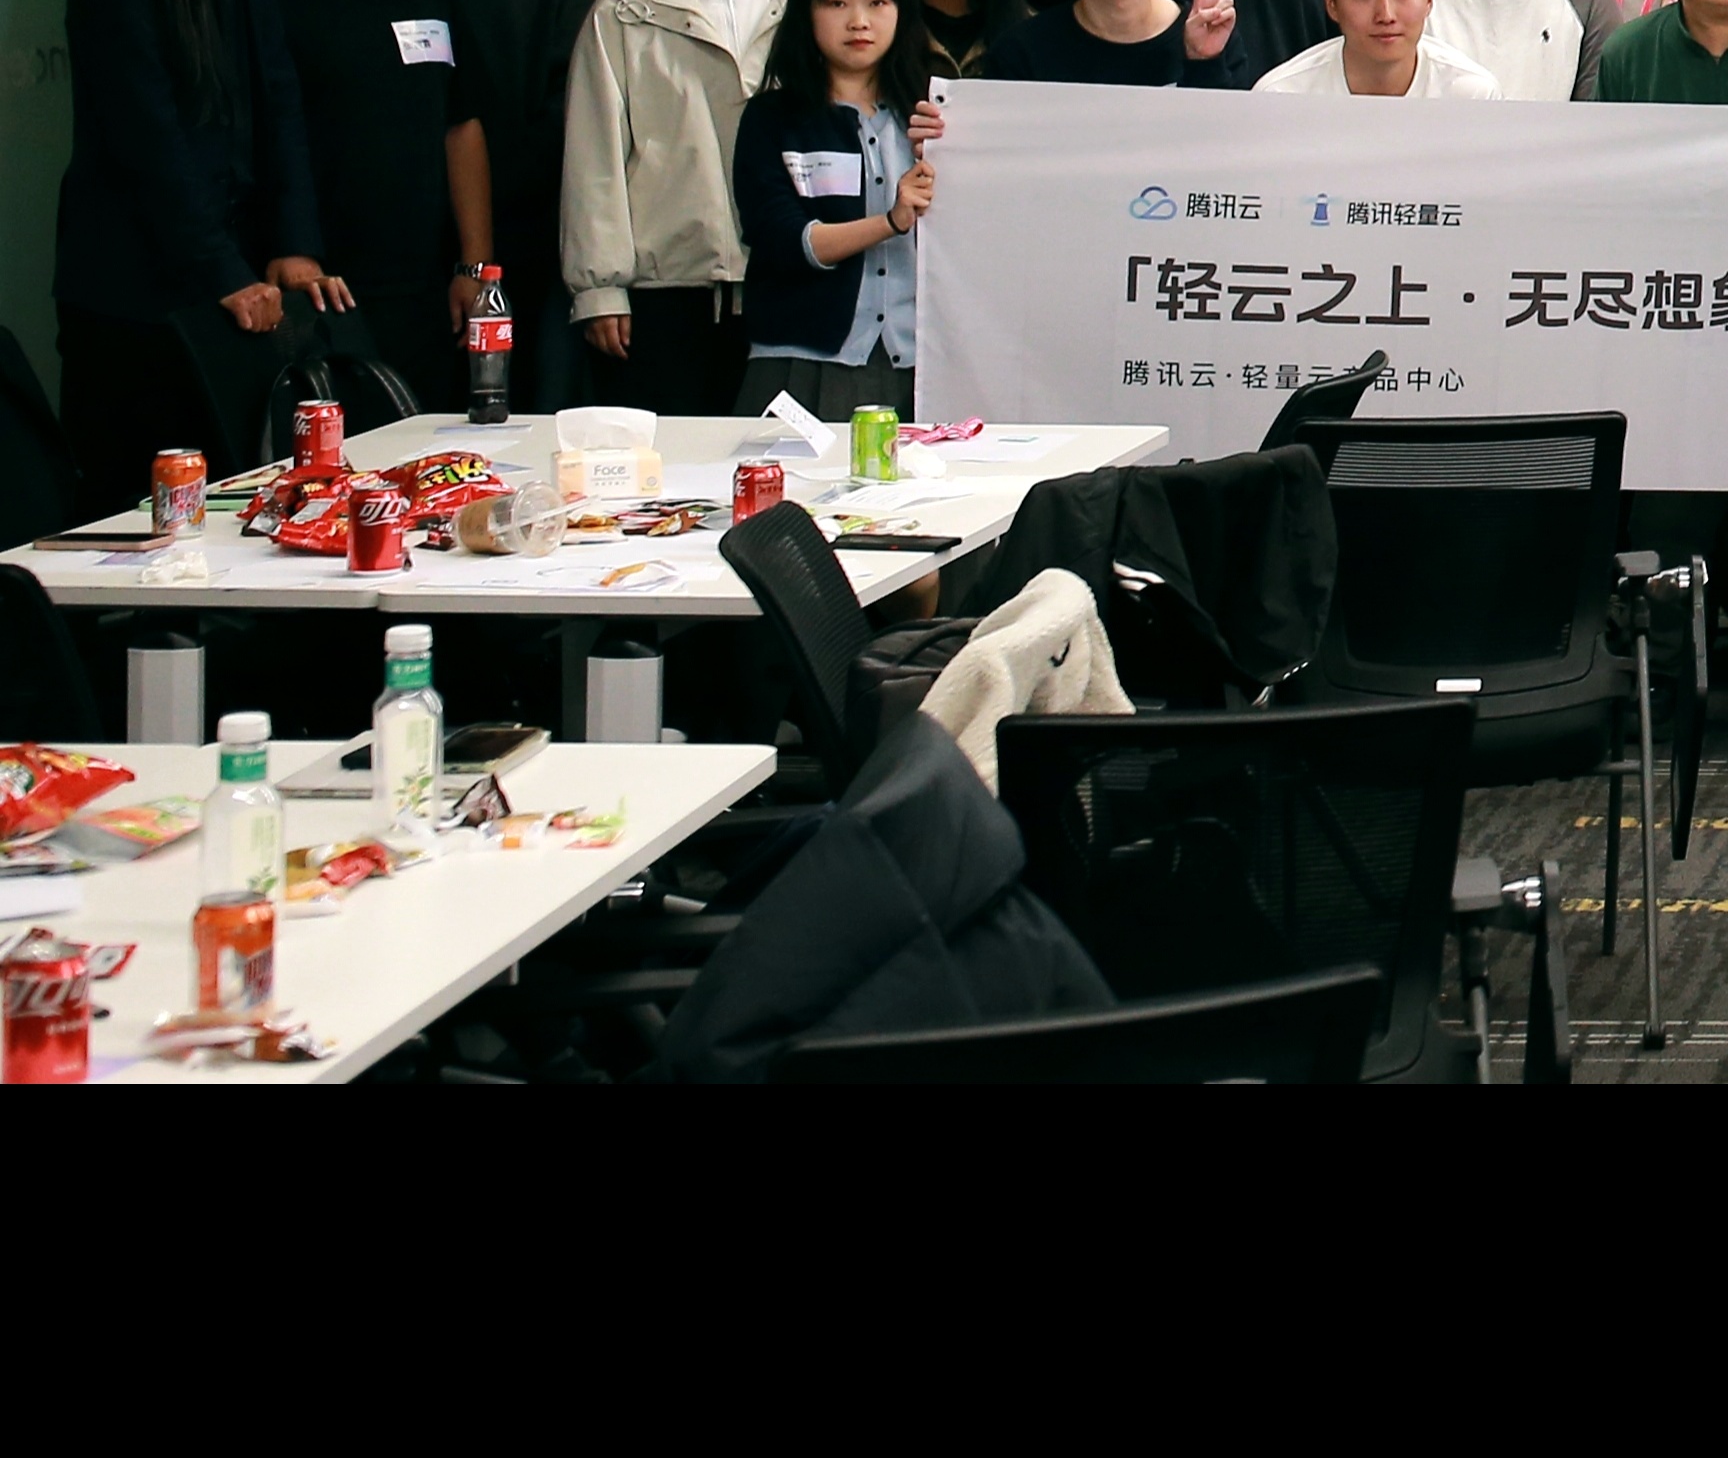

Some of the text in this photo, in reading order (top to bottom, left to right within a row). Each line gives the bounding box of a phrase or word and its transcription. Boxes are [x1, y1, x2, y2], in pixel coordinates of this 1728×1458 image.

[1186, 192, 1262, 220] 腾讯云
[1346, 202, 1463, 226] 腾讯轻量云
[1122, 359, 1465, 393] 腾讯云·轻量云品中心
[593, 464, 626, 477] Face
